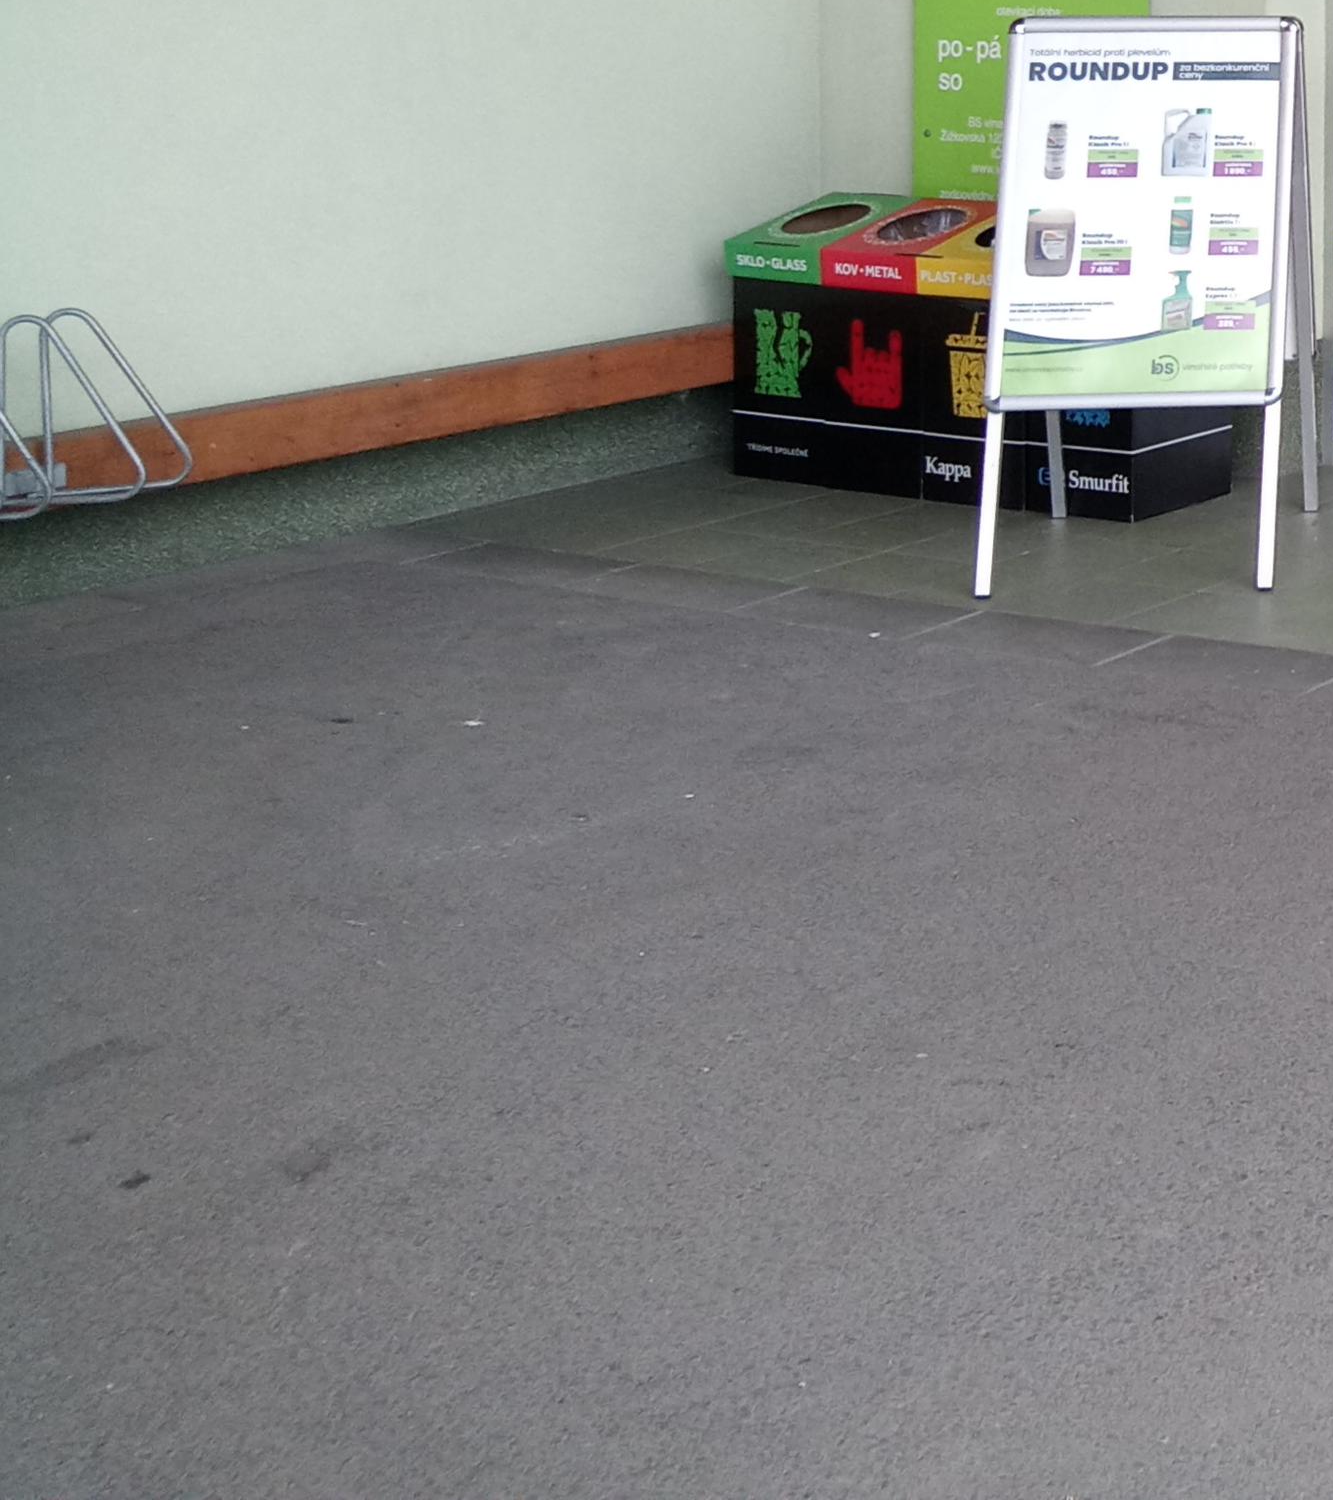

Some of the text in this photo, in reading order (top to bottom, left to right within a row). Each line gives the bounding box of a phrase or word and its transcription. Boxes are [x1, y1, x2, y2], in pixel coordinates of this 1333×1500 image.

[1028, 61, 1169, 81] ROUNDUP
[938, 73, 962, 90] so
[736, 254, 808, 272] SKLO GLASS
[835, 262, 902, 280] KOV METAL
[920, 271, 992, 287] PLAST PLAS
[925, 456, 972, 482] Kappa
[1068, 470, 1129, 494] Smurfit
